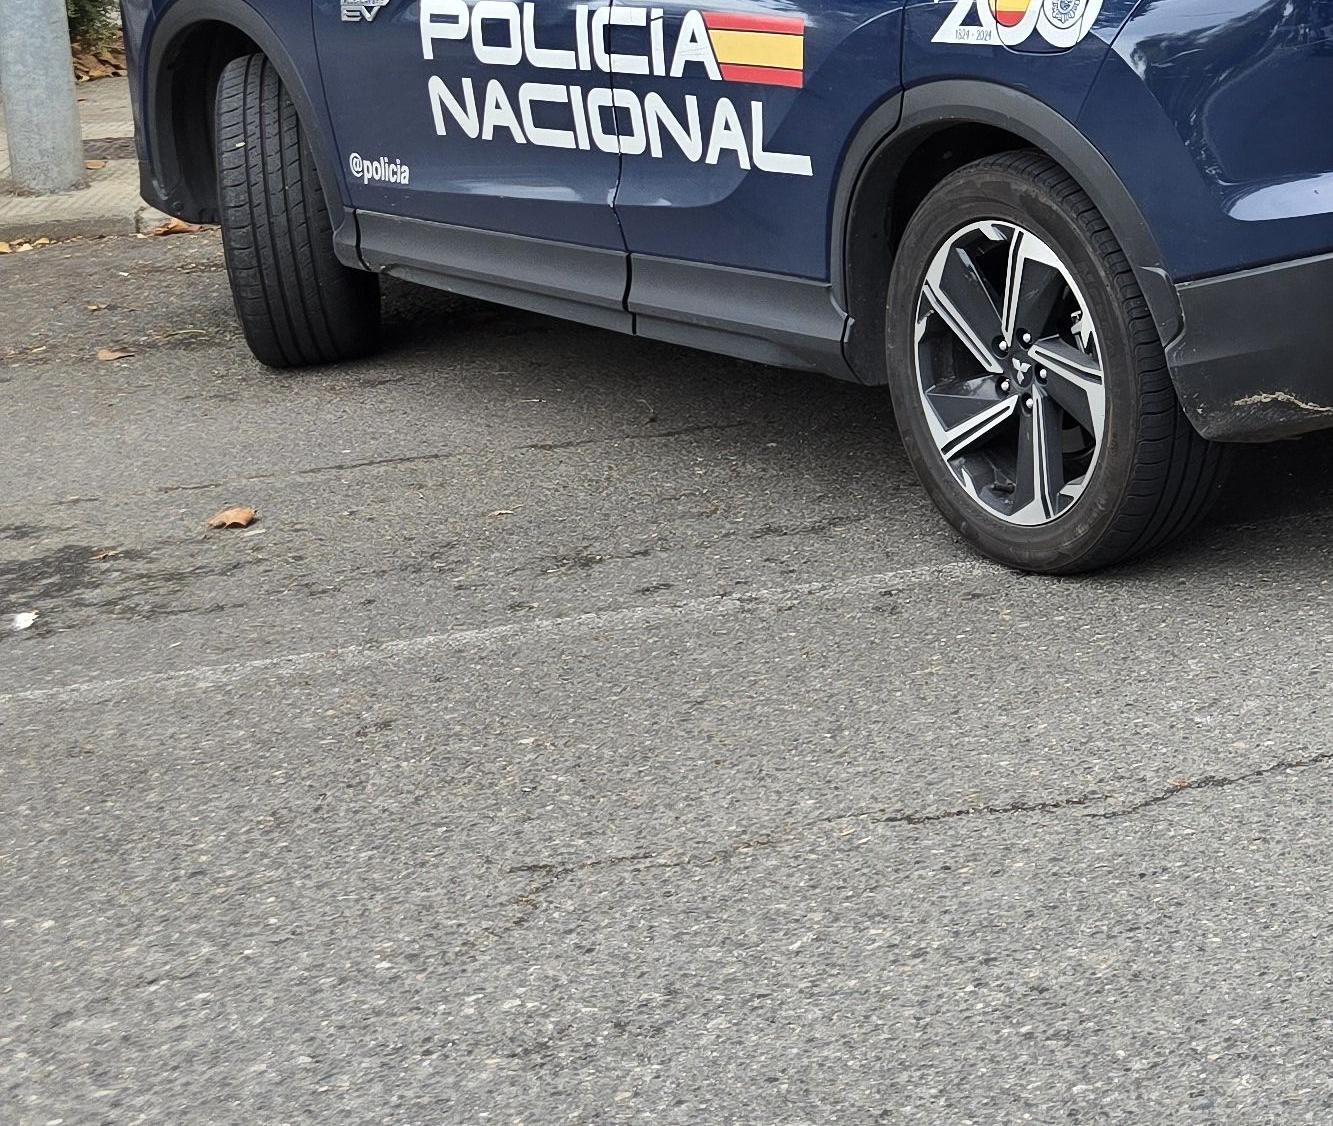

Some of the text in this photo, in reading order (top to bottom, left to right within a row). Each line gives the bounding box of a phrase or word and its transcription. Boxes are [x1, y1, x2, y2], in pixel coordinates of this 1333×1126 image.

[341, 5, 380, 22] EV
[427, 75, 814, 177] NACIONAL
[348, 152, 410, 185] @policia
